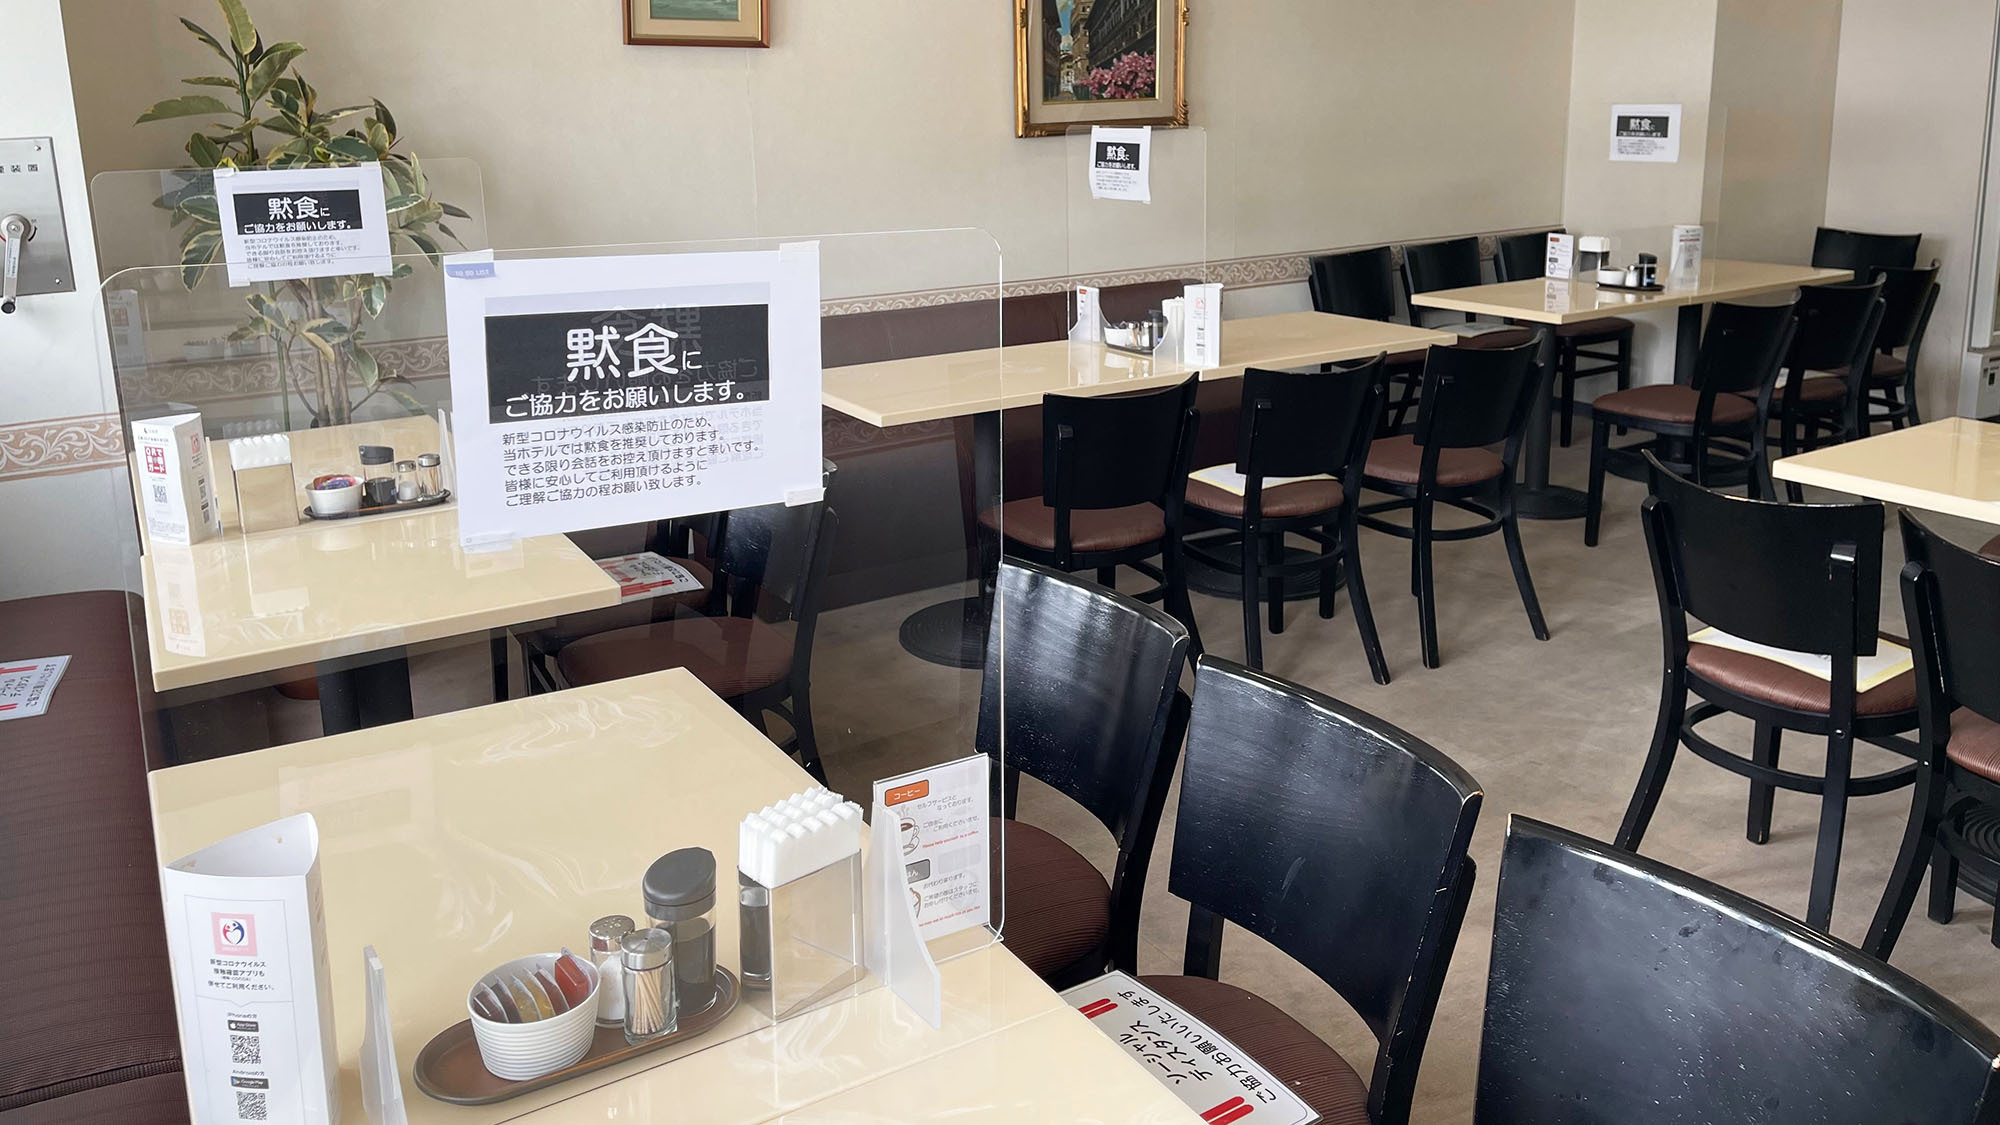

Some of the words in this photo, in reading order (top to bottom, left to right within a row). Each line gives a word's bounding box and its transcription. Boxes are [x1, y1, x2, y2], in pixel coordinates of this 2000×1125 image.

[268, 196, 330, 220] 黙食に
[244, 220, 351, 234] ご協力をお願いします。
[566, 322, 703, 382] 黙食に
[505, 379, 745, 418] ご協力をお願いします。
[502, 417, 714, 446] 新型コロナウイルス感染防止のため、
[503, 430, 726, 462] 当ホテルでは黙食を推奨しております。
[504, 441, 760, 476] できる限り会話をお控え頂けますと幸いです。
[505, 459, 709, 492] 皆様に安心してご利用頂けるように
[505, 479, 703, 507] ご理解ご協力の程お願い致します。
[1117, 990, 1277, 1104] ご協力お願いいたします
[1119, 1032, 1188, 1085] ソーシャル
[1129, 1019, 1214, 1082] ディスタンス
